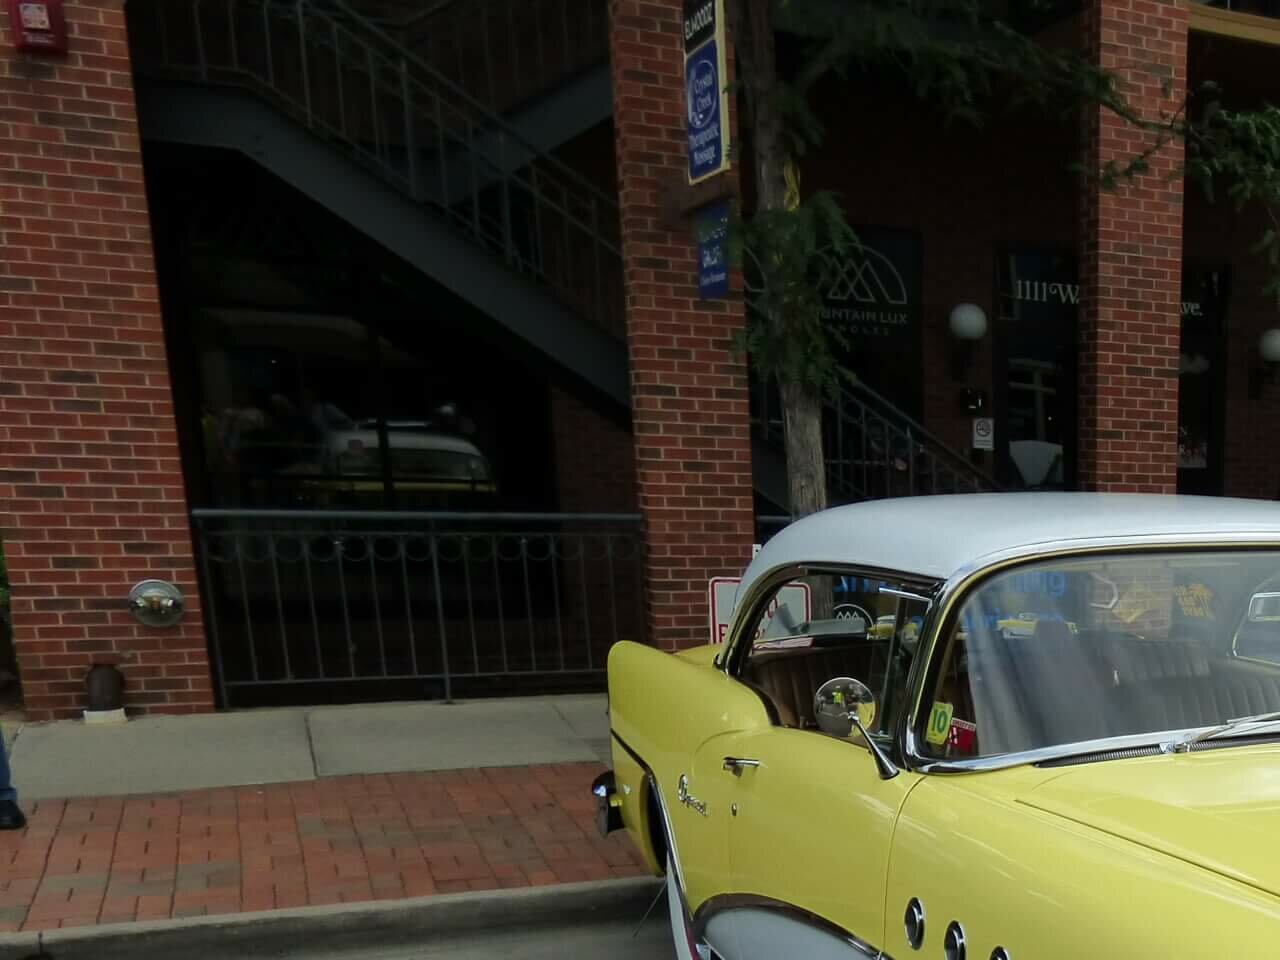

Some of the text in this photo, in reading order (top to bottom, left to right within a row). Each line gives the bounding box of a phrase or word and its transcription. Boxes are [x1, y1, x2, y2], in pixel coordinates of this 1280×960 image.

[1015, 279, 1047, 302] 1111
[879, 312, 908, 325] LUX
[931, 708, 949, 734] 10
